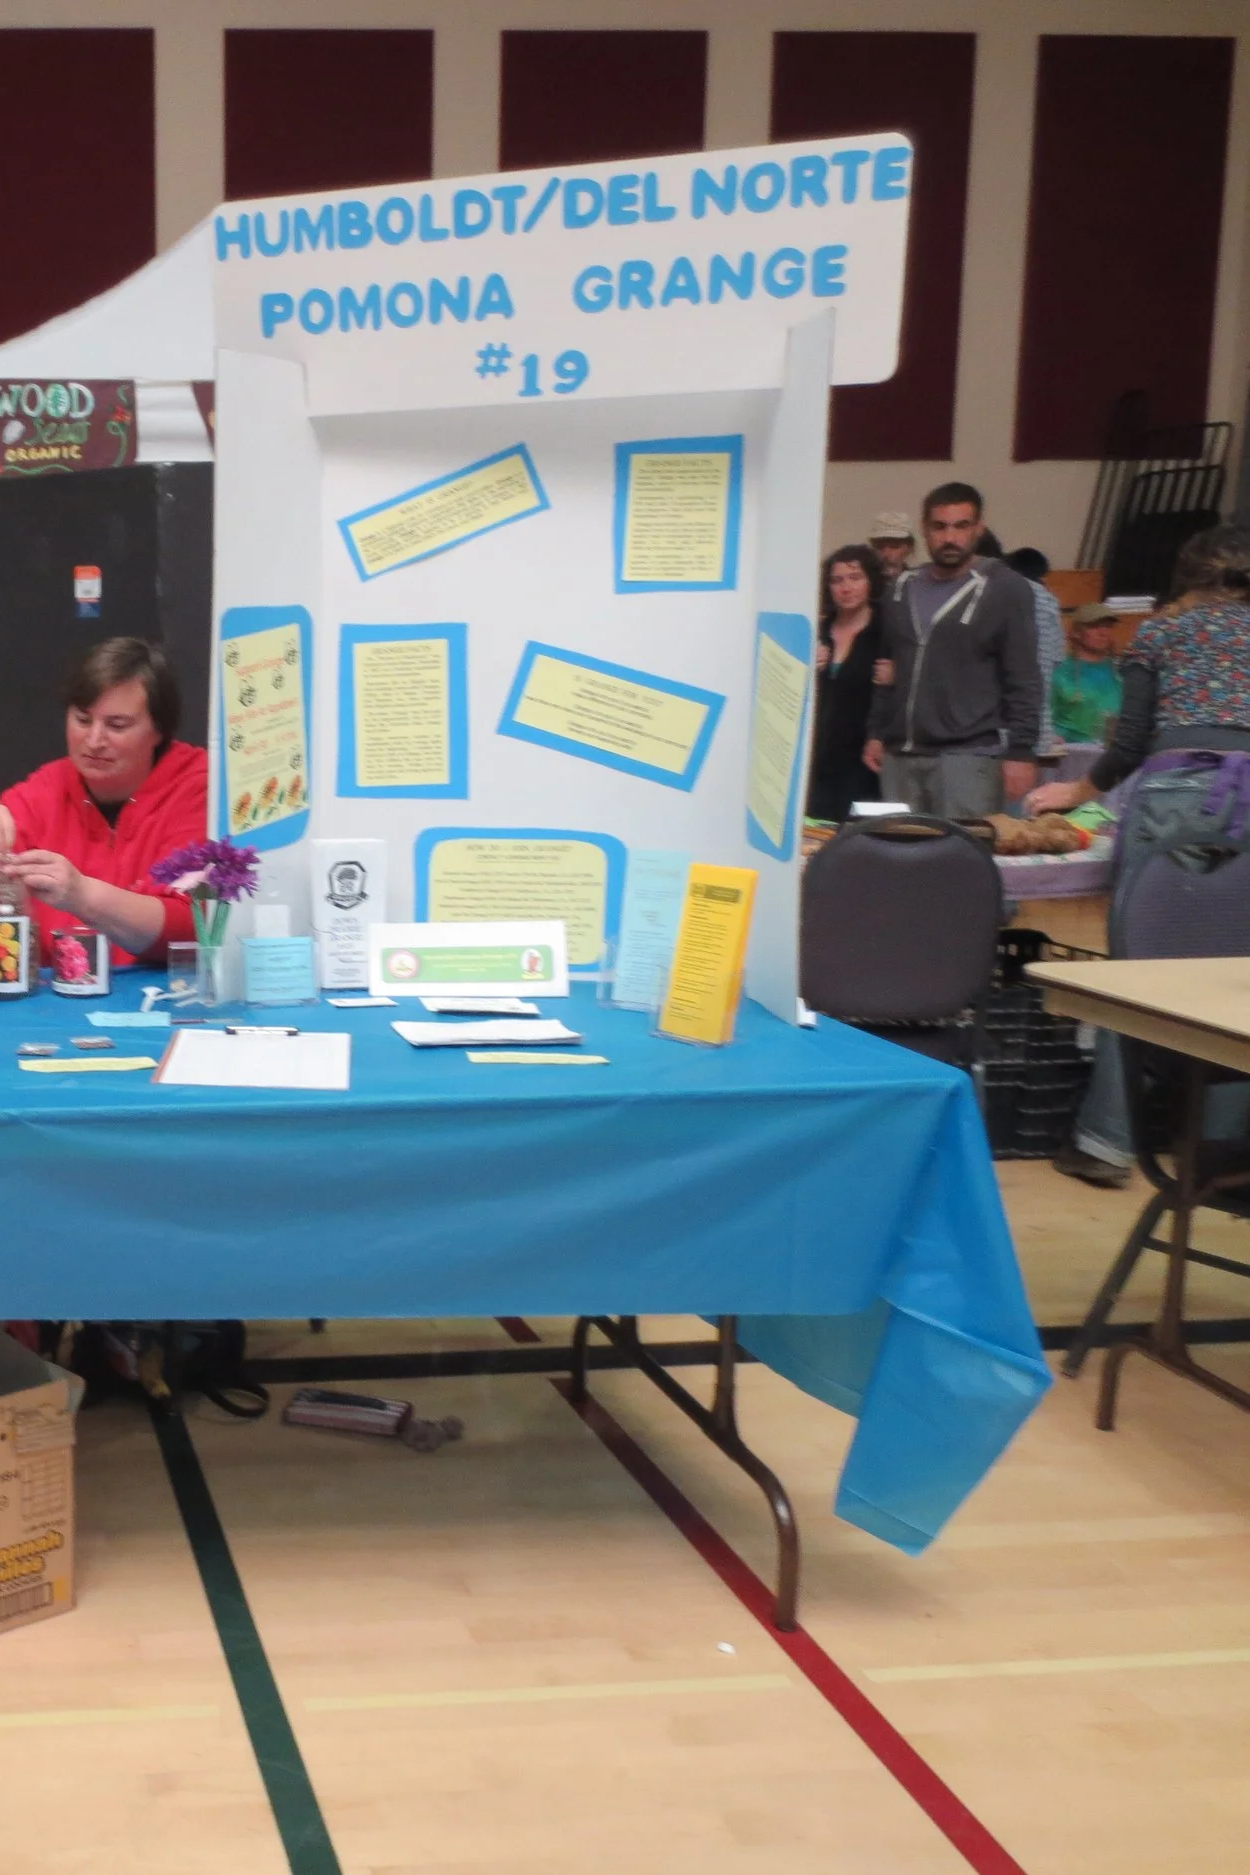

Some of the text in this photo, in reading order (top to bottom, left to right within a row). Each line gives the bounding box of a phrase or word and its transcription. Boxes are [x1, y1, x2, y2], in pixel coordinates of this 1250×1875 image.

[214, 146, 913, 262] HUMBOLDT/DEL NORTE
[260, 244, 849, 339] POMONA GRANGE
[474, 341, 590, 398] #19
[4, 445, 83, 463] ORGANIC
